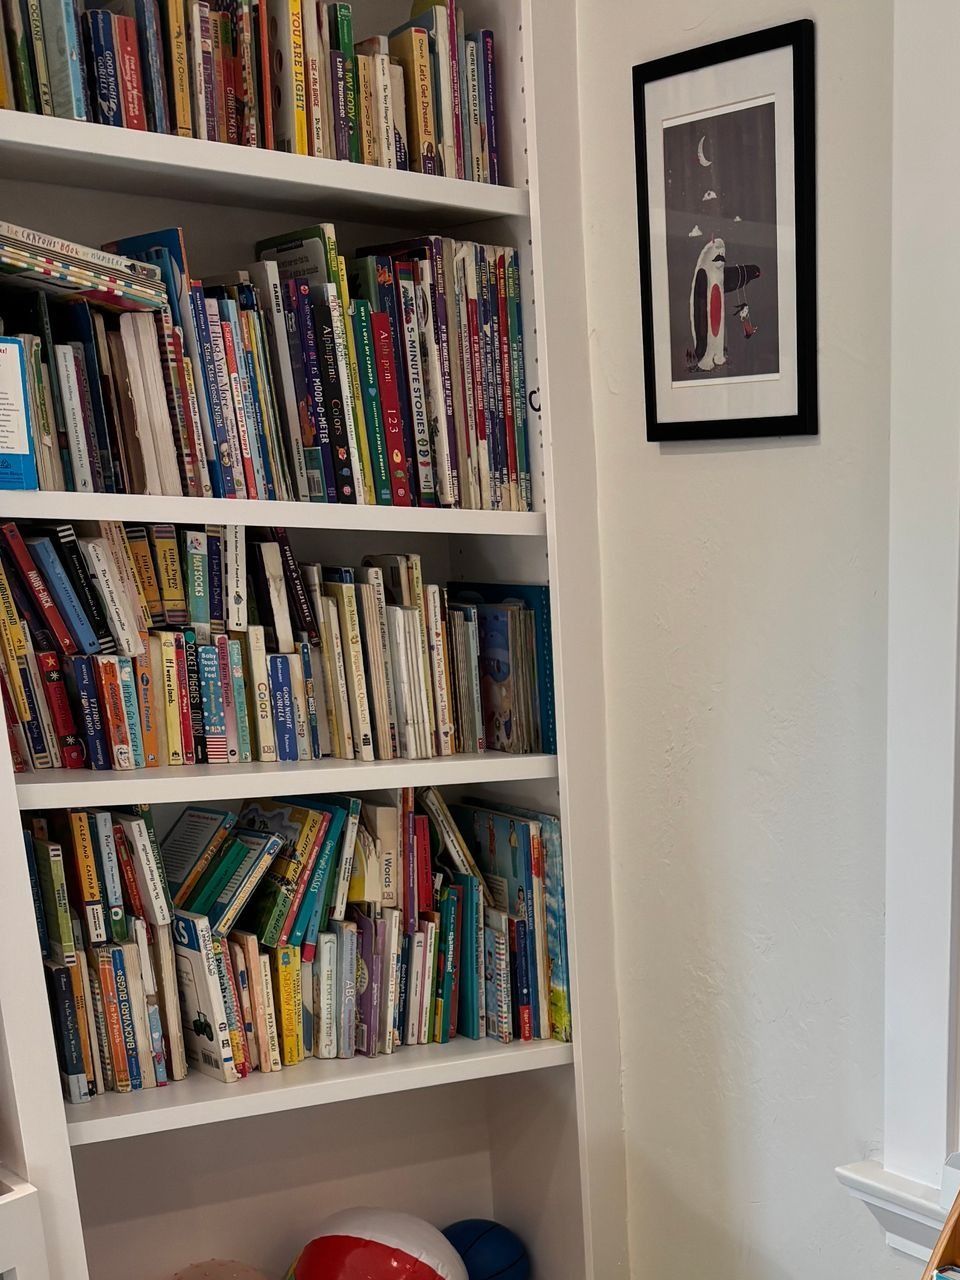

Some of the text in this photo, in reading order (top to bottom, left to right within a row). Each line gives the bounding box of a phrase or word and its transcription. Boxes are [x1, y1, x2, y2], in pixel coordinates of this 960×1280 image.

[30, 4, 41, 41] OCEANS
[104, 51, 115, 76] GOOD
[177, 53, 184, 65] My
[292, 11, 305, 111] YOU ARE LIGHT
[226, 87, 237, 139] CHRISTMAS
[322, 325, 344, 436] Alphaprints Colors
[406, 326, 425, 435] 5-MINUTE STORIES
[312, 378, 329, 444] MOOD-O-METER
[27, 570, 53, 609] MOBY-DICK
[193, 554, 204, 596] HATSOCKS
[284, 546, 294, 570] PRIDE
[293, 580, 312, 623] PREJUDICE
[257, 683, 268, 719] Colors
[276, 691, 285, 721] GORILLA
[383, 858, 392, 888] Words
[116, 975, 136, 1048] BACKYARD BUGS
[345, 980, 355, 1004] ABC
